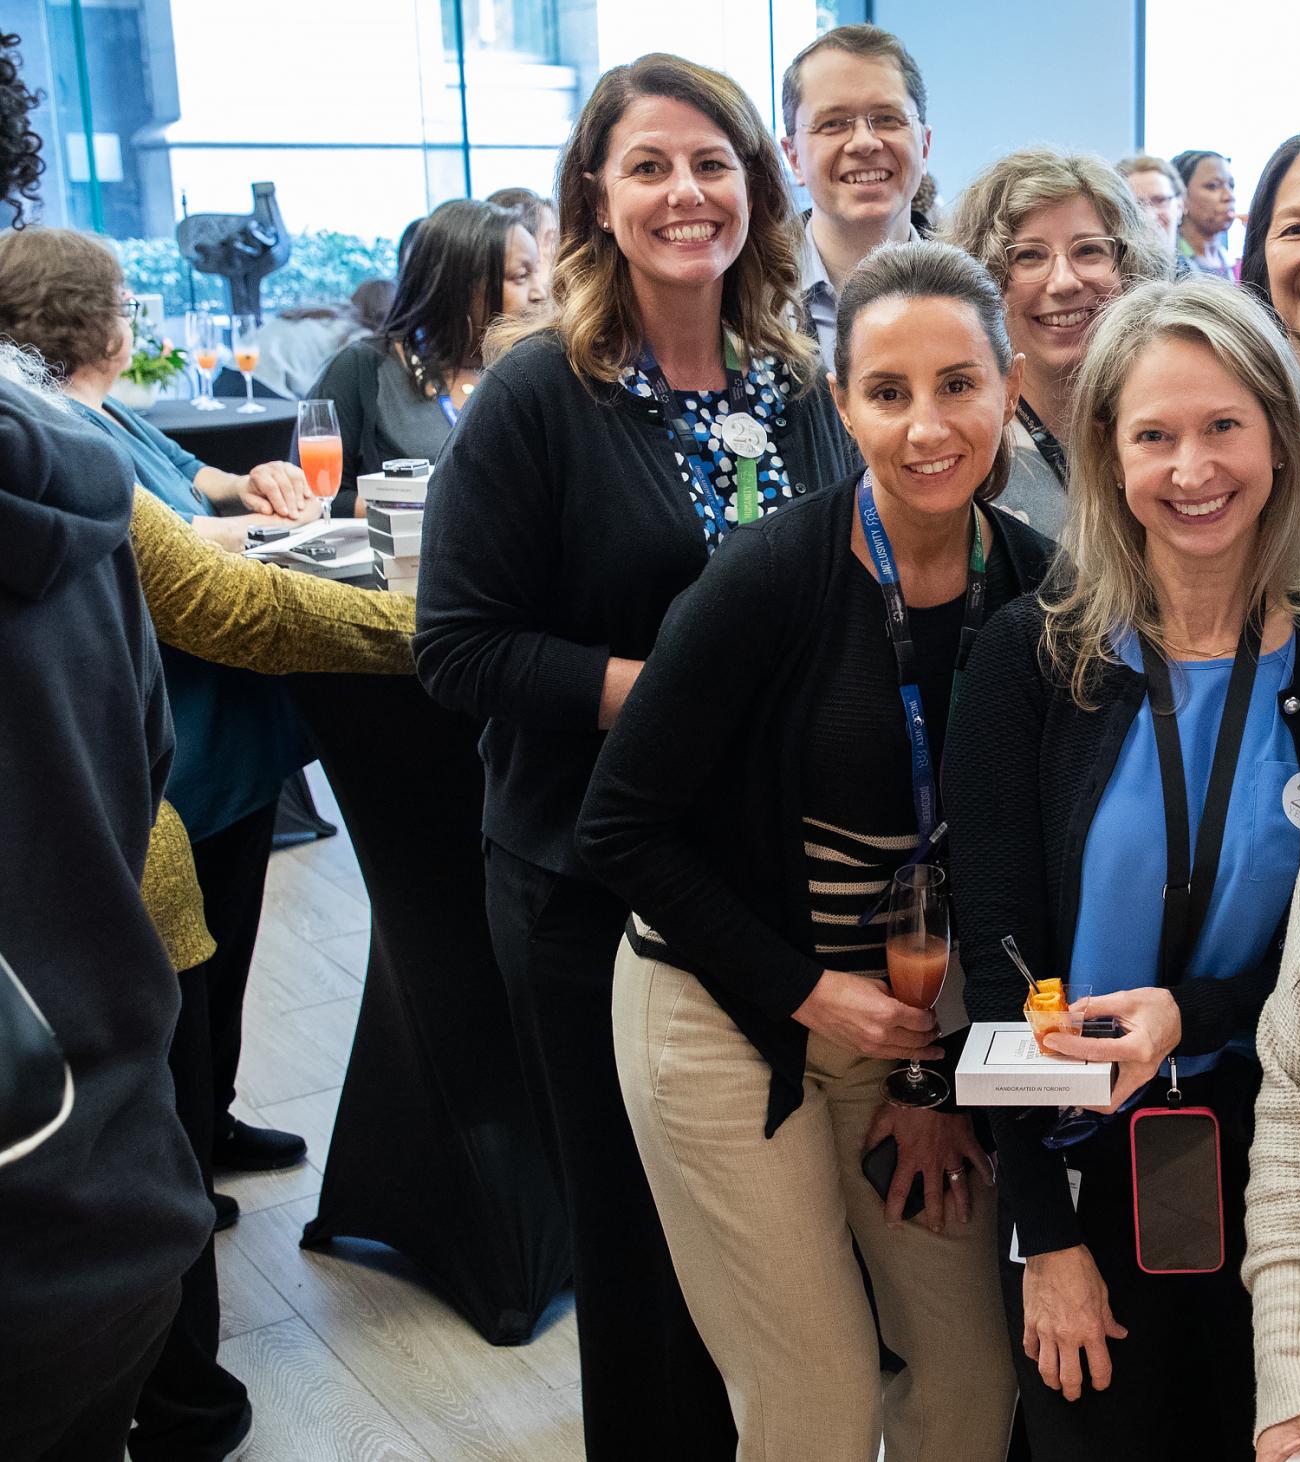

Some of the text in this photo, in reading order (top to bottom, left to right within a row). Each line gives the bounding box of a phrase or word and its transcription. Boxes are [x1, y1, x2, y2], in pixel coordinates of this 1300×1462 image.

[743, 486, 753, 519] HUMANITY
[870, 529, 893, 575] INCLUSIVITY
[908, 700, 924, 746] INCLVITY
